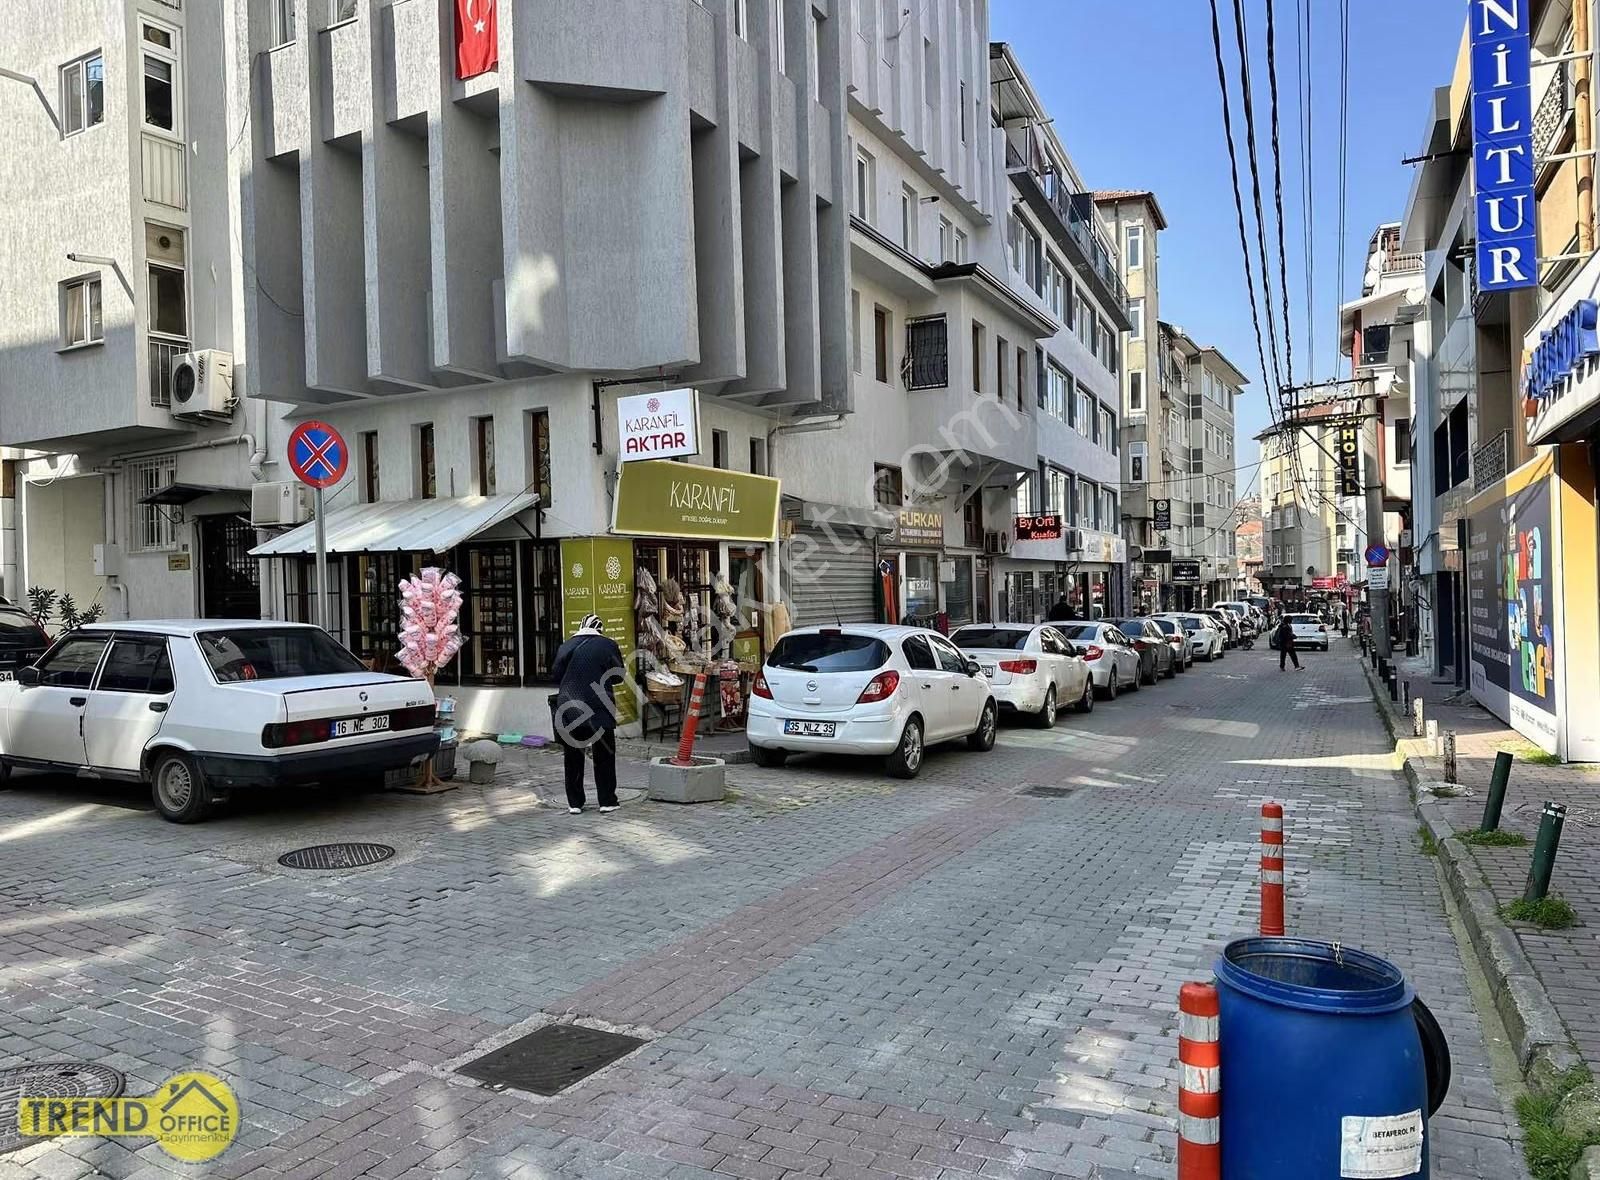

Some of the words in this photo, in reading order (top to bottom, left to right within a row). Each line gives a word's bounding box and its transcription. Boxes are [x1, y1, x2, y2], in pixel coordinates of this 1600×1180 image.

[625, 410, 684, 433] KARANFİL
[626, 431, 687, 454] AKTAR
[1342, 429, 1356, 493] HOTEL
[669, 480, 740, 514] KARANFİL
[900, 511, 942, 528] FURKAN
[1019, 517, 1033, 530] By
[337, 723, 347, 734] 16
[353, 720, 364, 731] NE
[372, 716, 388, 729] 302
[789, 722, 800, 731] 35
[803, 723, 820, 732] NLZ
[823, 723, 834, 733] 35
